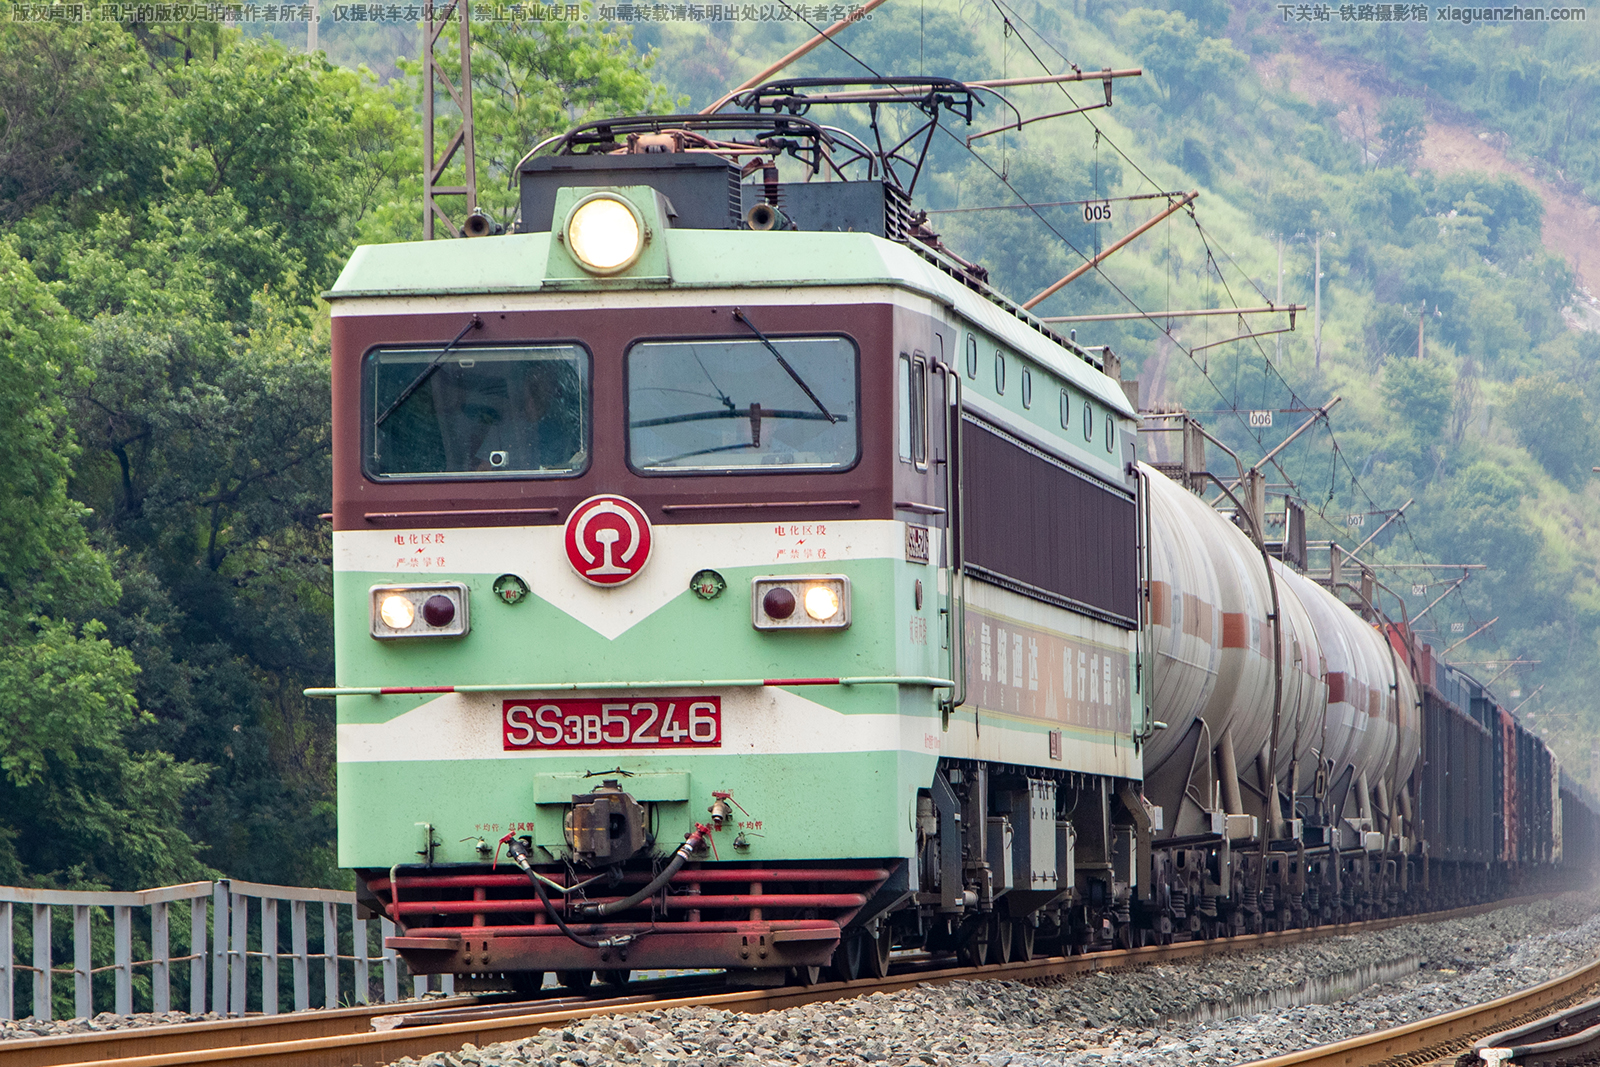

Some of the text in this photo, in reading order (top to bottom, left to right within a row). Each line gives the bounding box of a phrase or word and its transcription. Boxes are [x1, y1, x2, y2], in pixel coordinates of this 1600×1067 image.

[1084, 204, 1112, 221] 005
[1251, 413, 1272, 425] 006
[1348, 515, 1364, 526] 007
[774, 524, 827, 537] 电化区段
[393, 532, 446, 546] 电化区段
[505, 589, 517, 599] W4
[701, 583, 714, 594] W2
[506, 702, 717, 746] SS3B5246
[474, 823, 500, 832] 平均管
[508, 822, 535, 832] 总风管
[738, 820, 763, 831] 平均管
